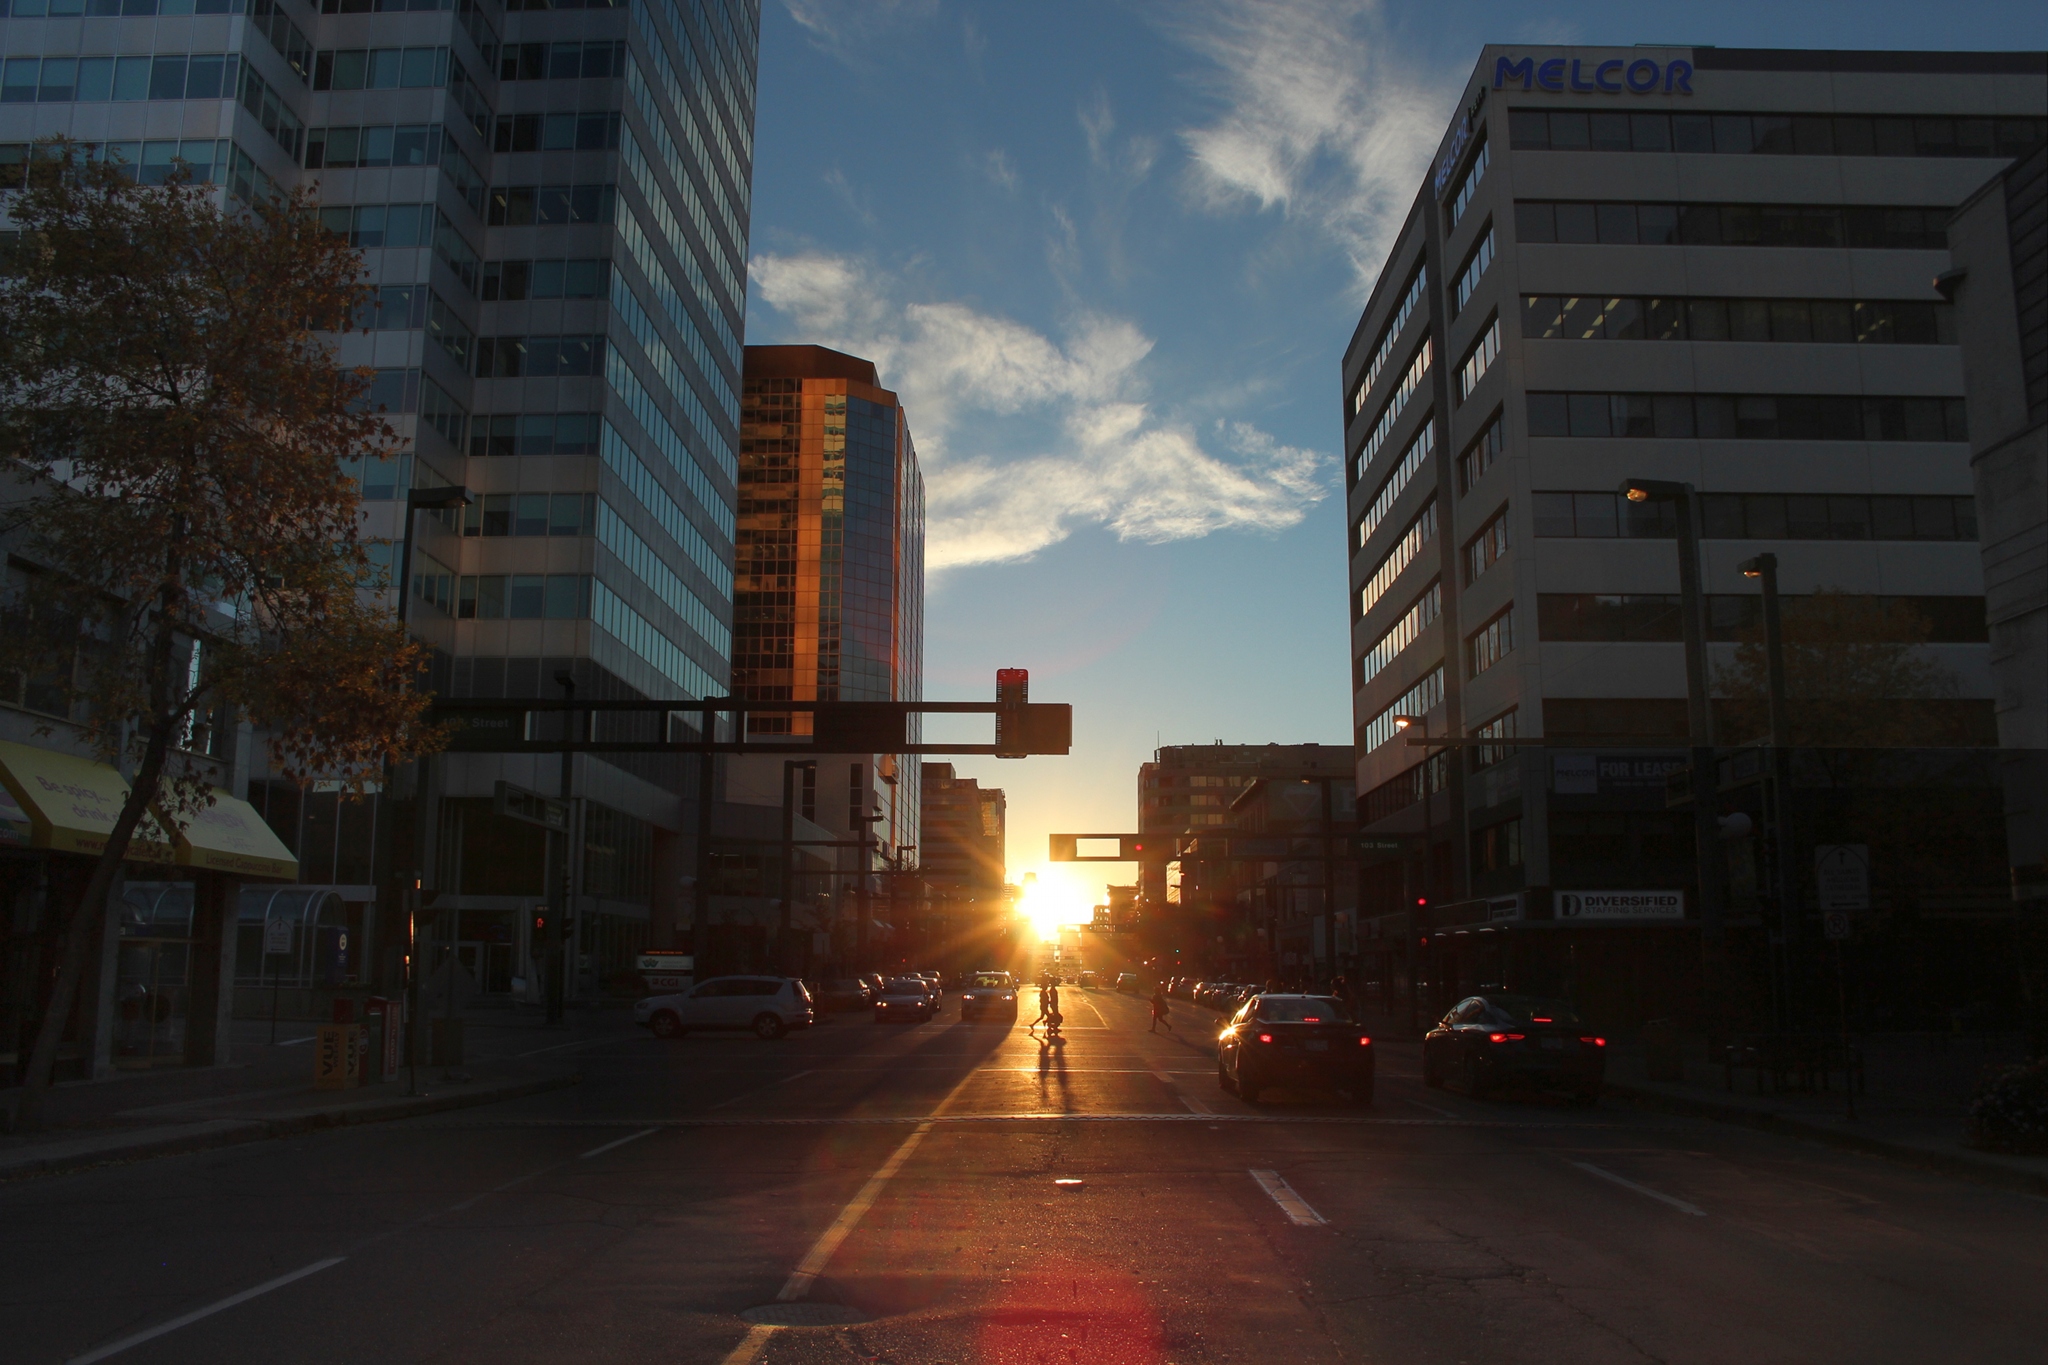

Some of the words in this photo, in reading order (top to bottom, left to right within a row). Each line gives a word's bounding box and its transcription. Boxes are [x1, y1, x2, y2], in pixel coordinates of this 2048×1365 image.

[1493, 56, 1693, 94] MELCOR
[1434, 116, 1468, 200] MELCOR
[443, 717, 466, 728] 10
[472, 717, 509, 728] Street
[1555, 769, 1596, 777] MELCOR
[1599, 762, 1630, 777] FOR
[36, 775, 63, 793] Be
[206, 853, 235, 867] Licensed
[271, 864, 283, 873] Bar
[1585, 896, 1678, 906] DIVERSIFIED
[660, 978, 679, 987] CGI
[322, 1031, 334, 1076] VUE
